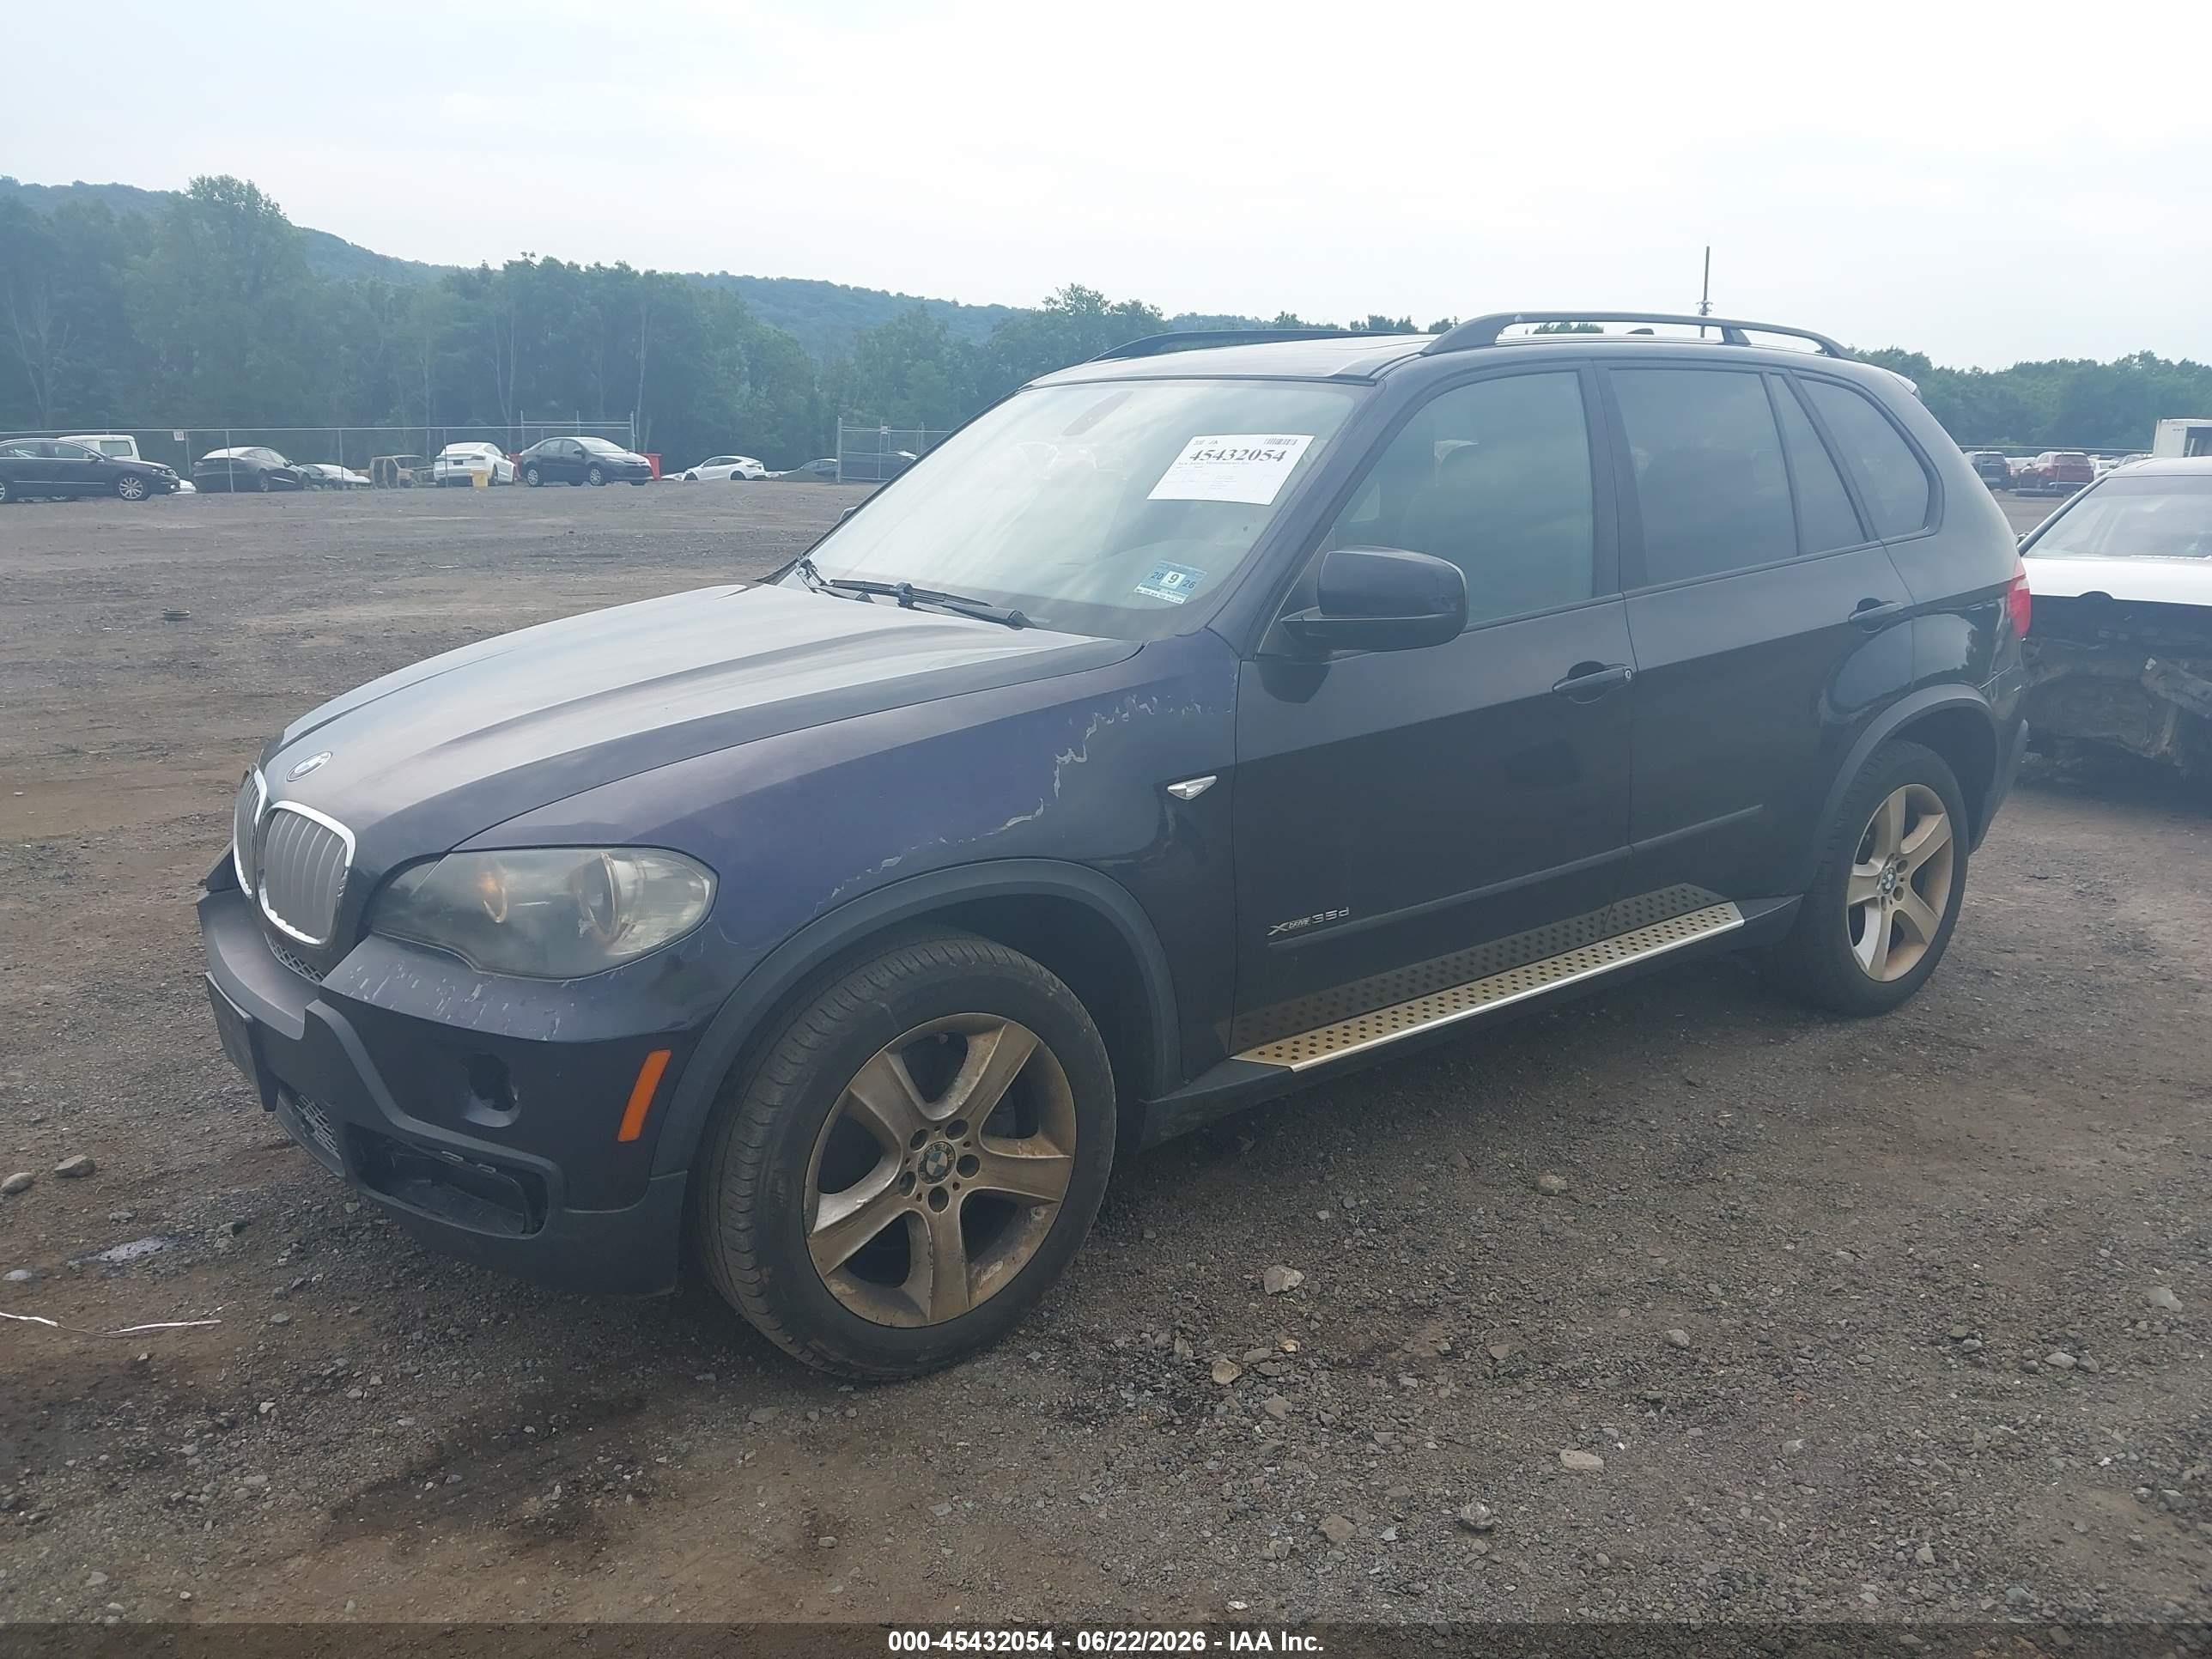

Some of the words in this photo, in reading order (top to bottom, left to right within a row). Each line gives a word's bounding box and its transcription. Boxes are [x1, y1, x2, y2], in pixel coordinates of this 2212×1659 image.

[1189, 449, 1287, 462] 45432054
[1151, 571, 1164, 580] 20
[1168, 574, 1180, 584] 9
[1182, 580, 1196, 589] 26
